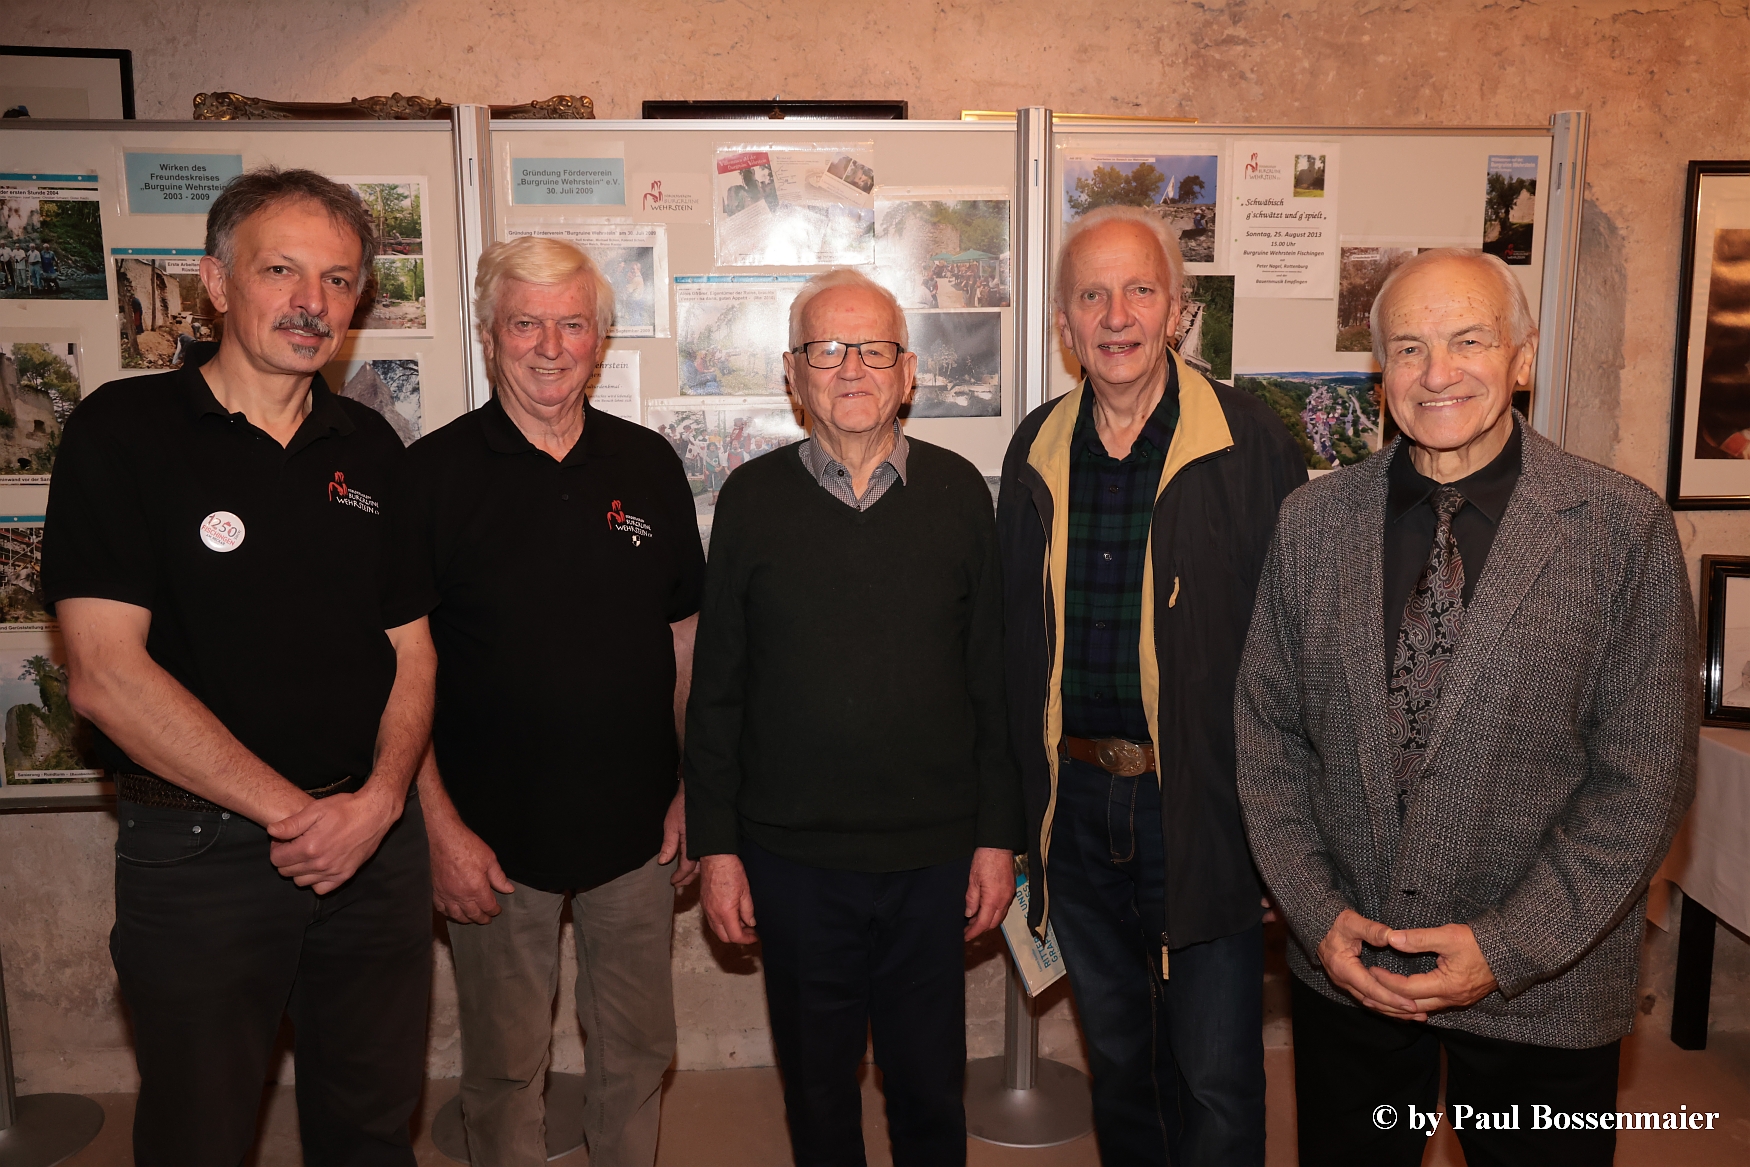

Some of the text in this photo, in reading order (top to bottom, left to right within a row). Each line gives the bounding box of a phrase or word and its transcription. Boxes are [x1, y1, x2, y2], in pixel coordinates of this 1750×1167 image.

[159, 163, 207, 172] Wirken des
[150, 172, 220, 181] Freundeskreises
[522, 169, 561, 178] Gründung
[163, 192, 183, 200] 2003
[190, 193, 210, 201] 2009
[1285, 211, 1299, 219] und
[1246, 230, 1272, 239] Sonntag,
[1284, 231, 1306, 239] August
[595, 361, 629, 369] ehrstein
[208, 514, 237, 537] 1250
[201, 524, 236, 546] FISCHINGEN
[1016, 890, 1028, 912] UND
